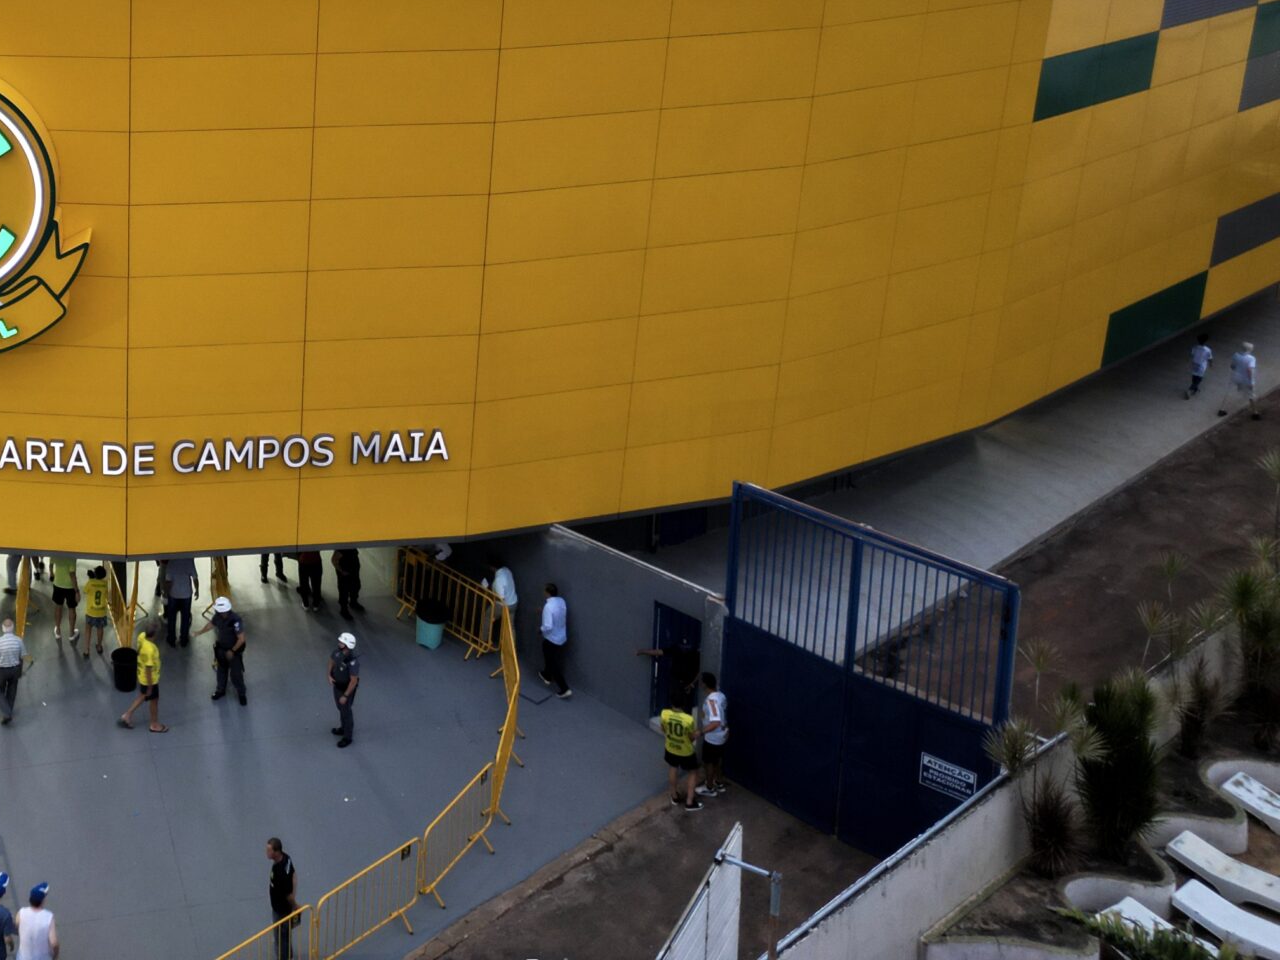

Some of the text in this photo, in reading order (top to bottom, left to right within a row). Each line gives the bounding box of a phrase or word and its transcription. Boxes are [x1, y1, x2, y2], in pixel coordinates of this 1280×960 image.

[101, 442, 156, 476] DE
[172, 434, 336, 474] CAMPOS
[351, 428, 450, 465] MAIA
[668, 720, 684, 738] 10
